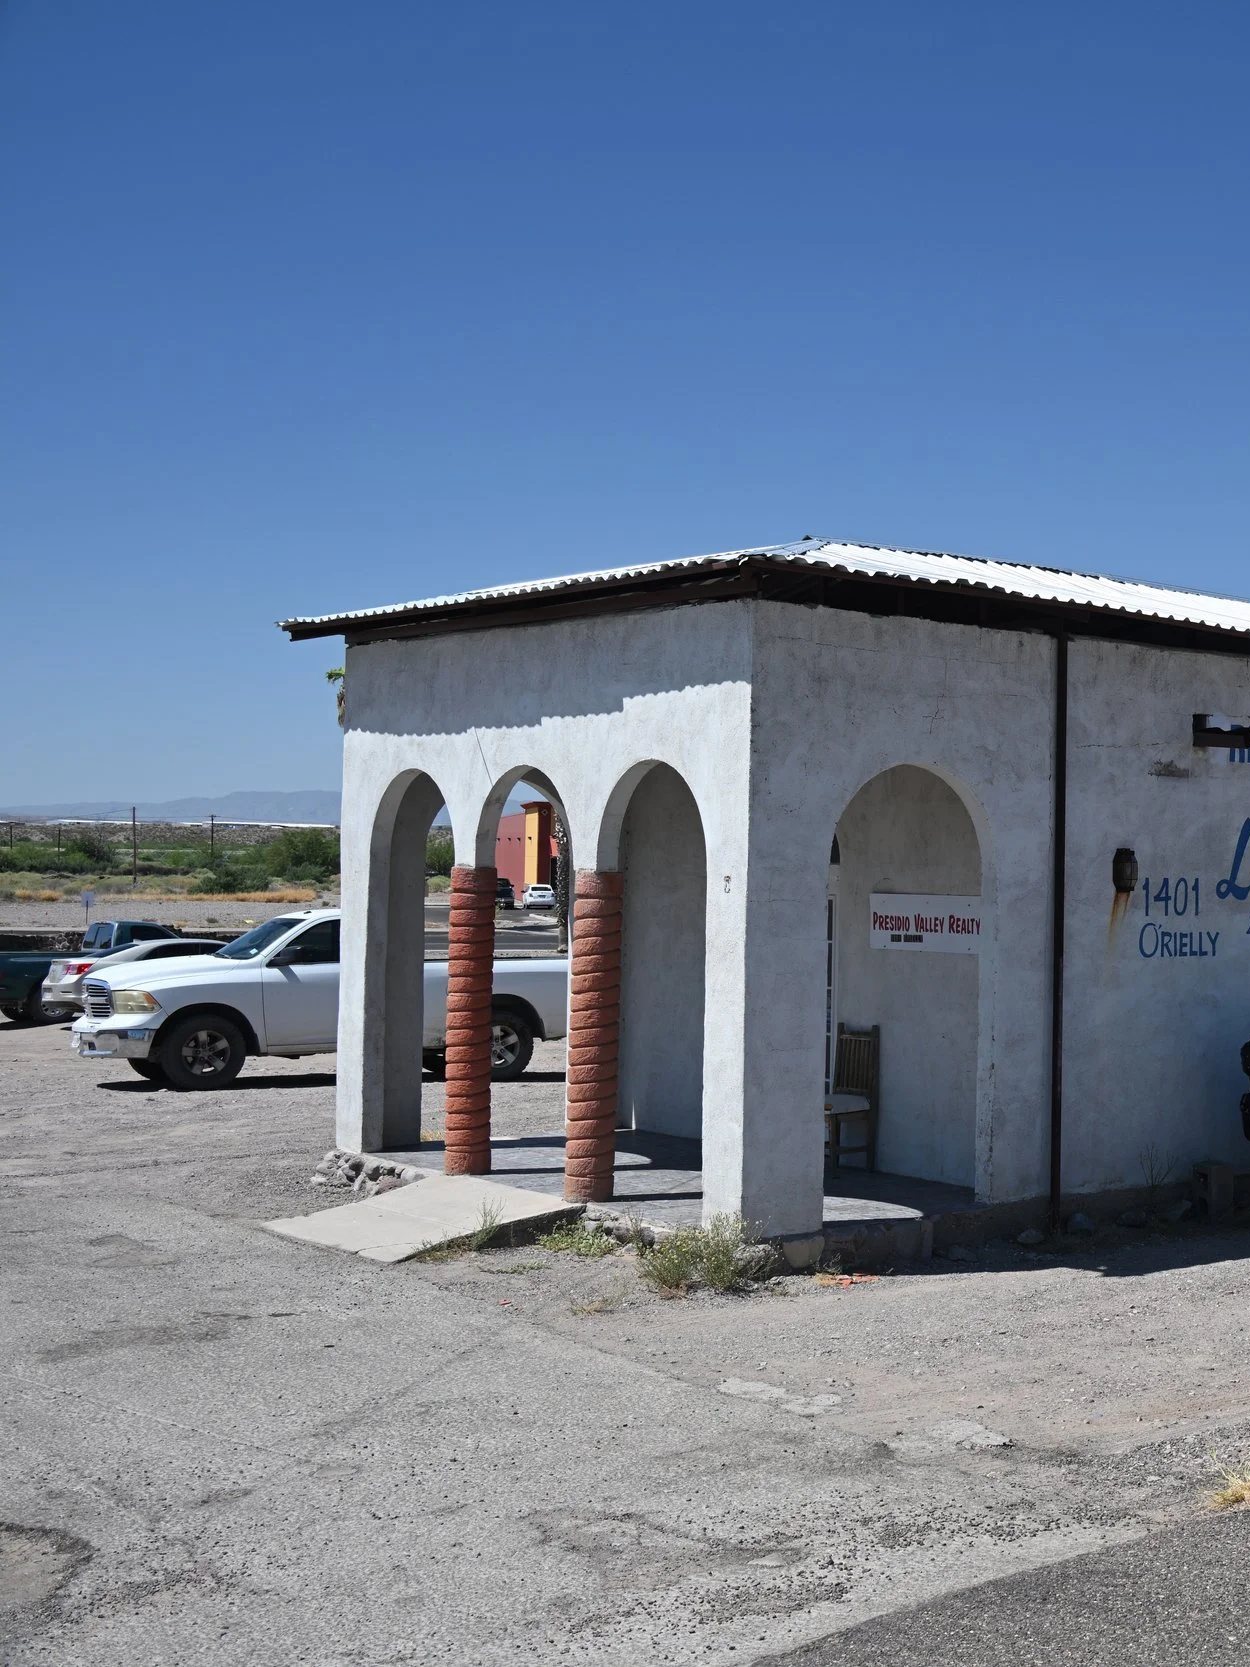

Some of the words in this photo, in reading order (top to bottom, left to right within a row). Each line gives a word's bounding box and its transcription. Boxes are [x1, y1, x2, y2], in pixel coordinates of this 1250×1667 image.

[1142, 877, 1200, 916] 1401
[873, 911, 910, 931] PRESIDIO
[914, 913, 945, 933] VALLEY
[948, 914, 980, 935] REALTY
